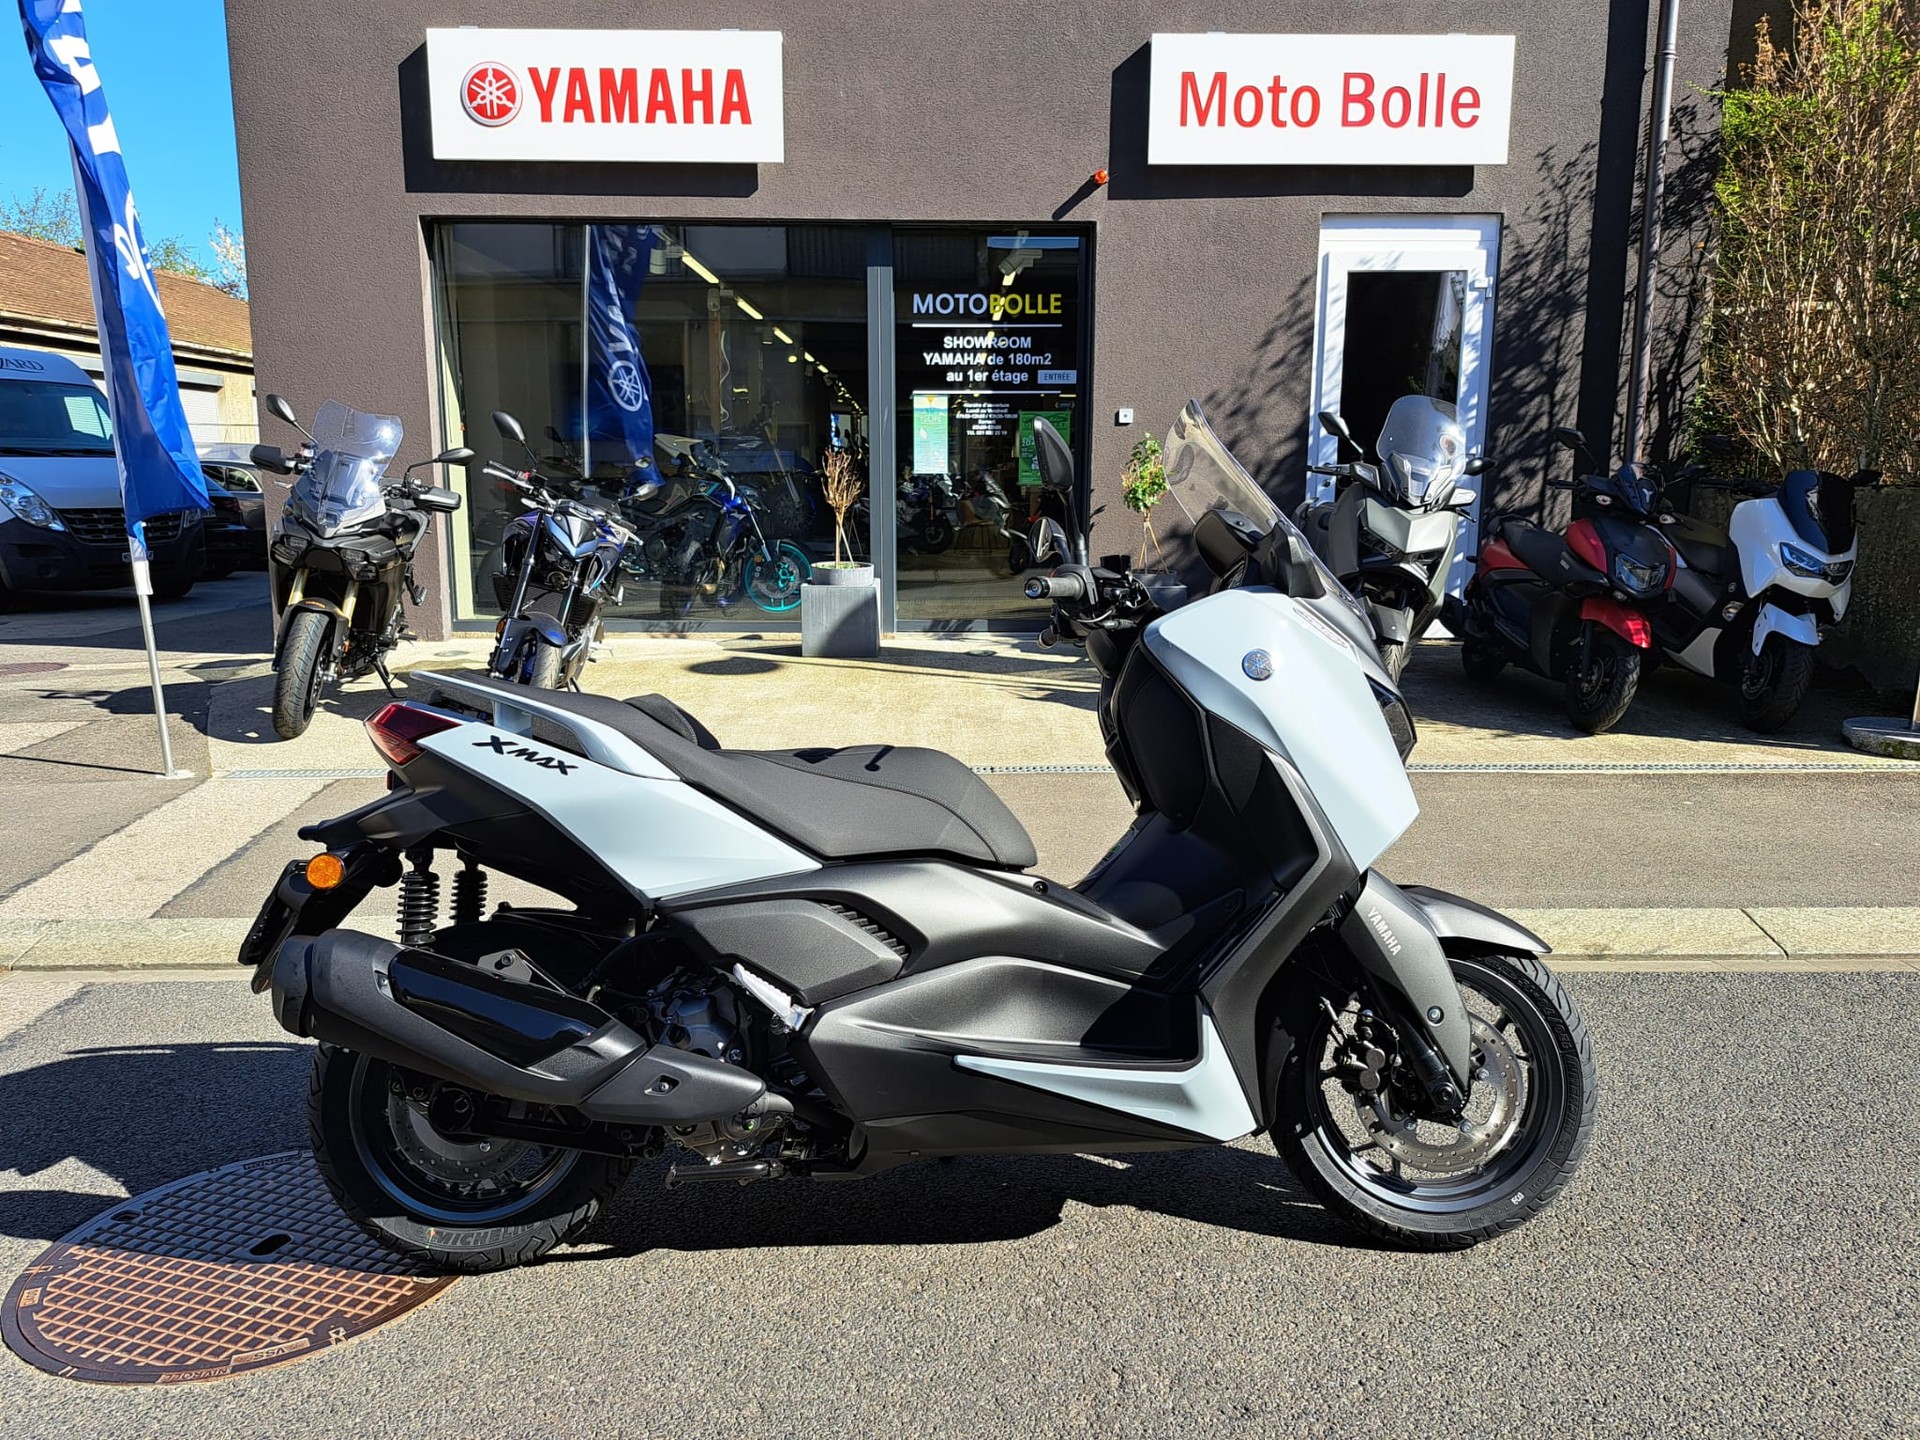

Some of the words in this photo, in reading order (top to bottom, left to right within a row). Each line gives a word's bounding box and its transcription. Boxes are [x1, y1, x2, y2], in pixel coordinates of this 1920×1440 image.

[528, 67, 752, 125] YAMAHA
[1180, 71, 1321, 128] Moto
[1341, 72, 1481, 129] Bolle
[912, 293, 1062, 315] MOTOBOLLE
[943, 336, 1032, 349] SHOWROOM
[923, 352, 985, 366] YAMAHA
[987, 353, 1004, 366] de
[1008, 353, 1052, 366] 180m2
[946, 371, 963, 382] au
[967, 369, 989, 382] 1er
[991, 369, 1029, 384] étage
[471, 734, 579, 776] XMAX
[1367, 906, 1402, 956] YAMAHA
[253, 1346, 286, 1360] VSS
